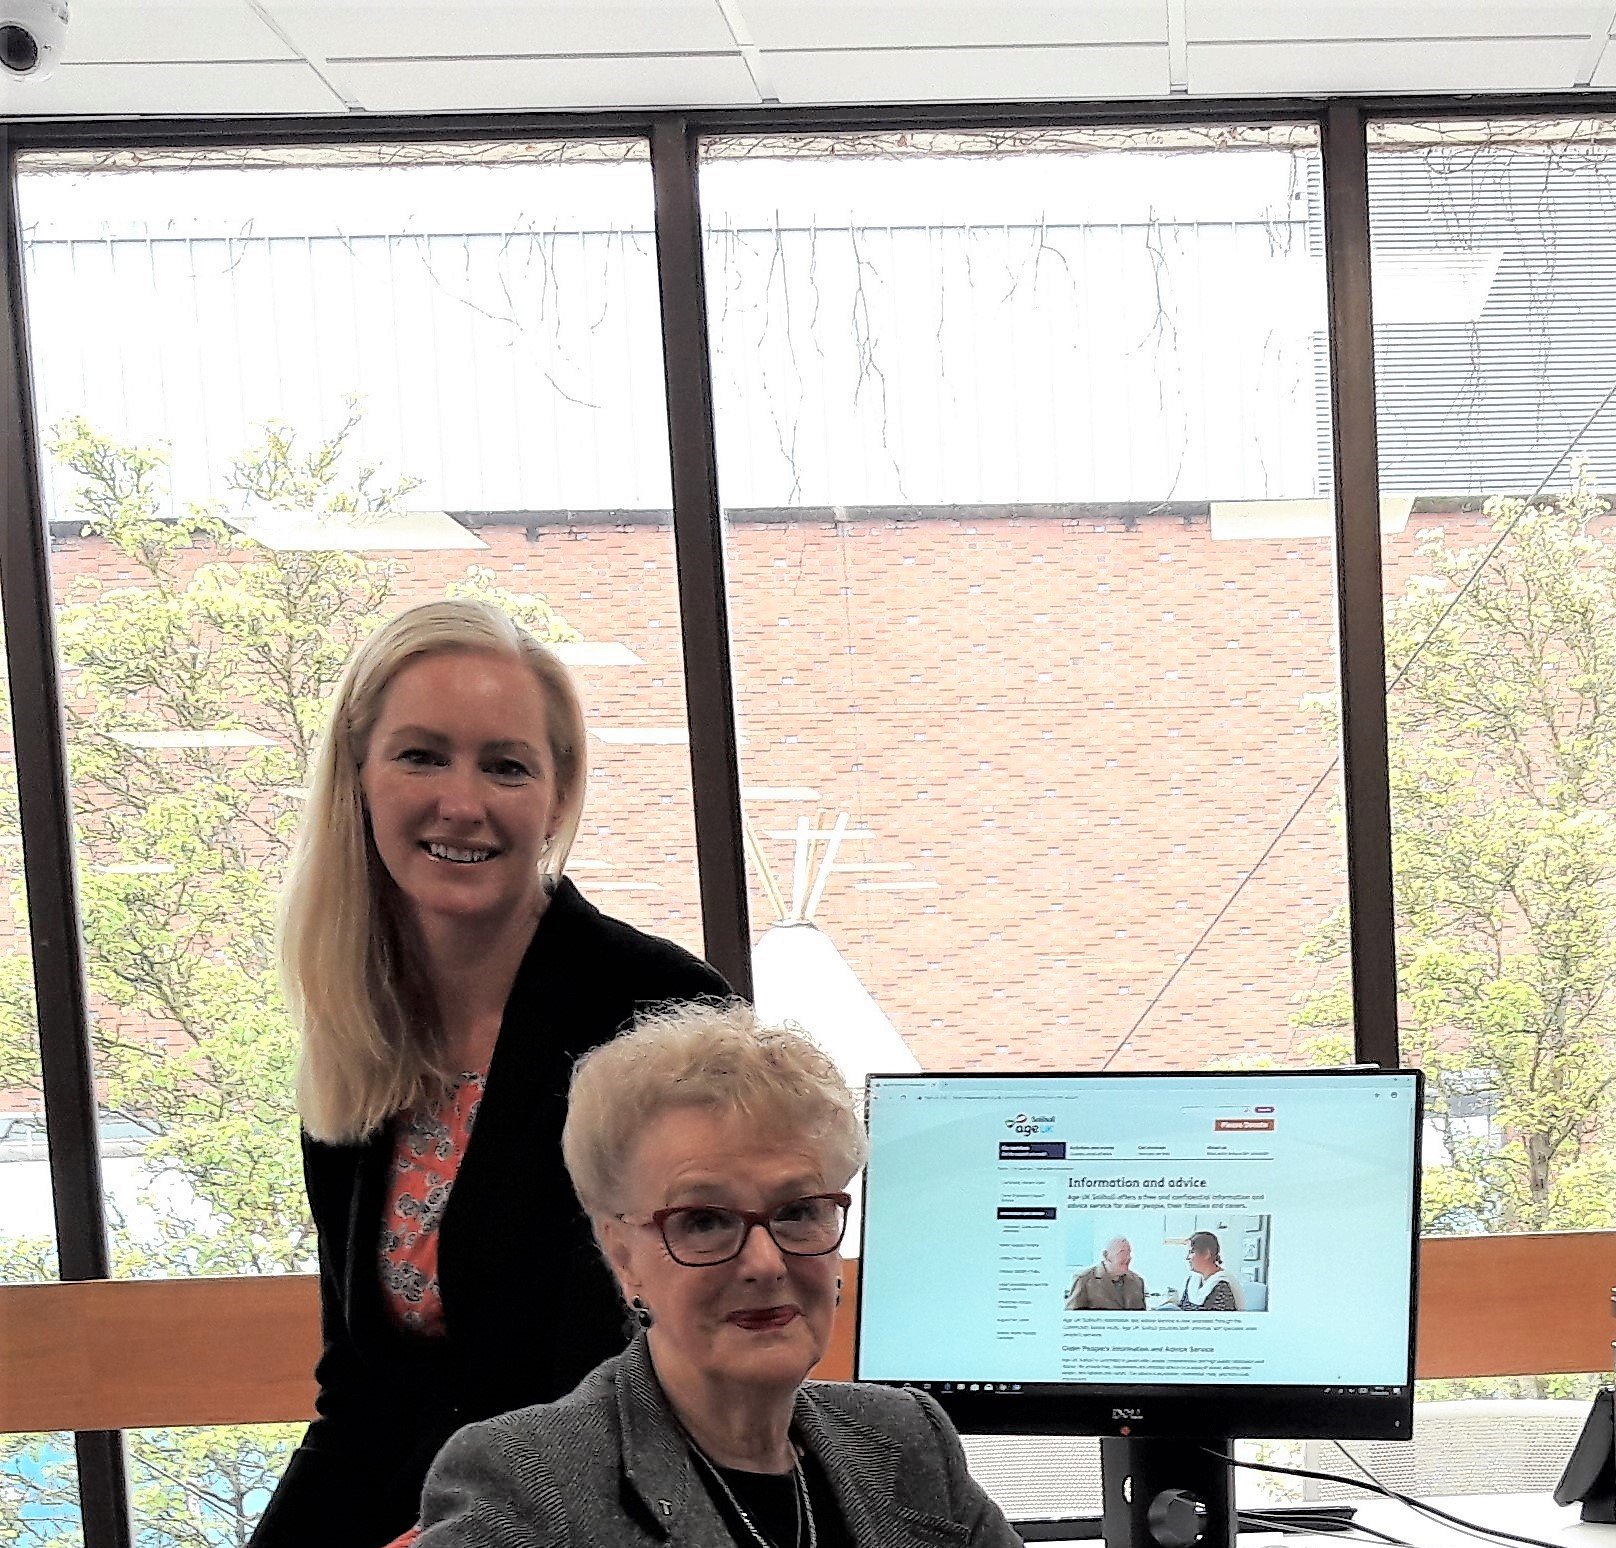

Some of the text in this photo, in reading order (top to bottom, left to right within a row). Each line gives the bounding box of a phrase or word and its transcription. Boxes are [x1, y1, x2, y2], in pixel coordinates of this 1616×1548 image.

[1015, 1124, 1040, 1136] age
[1068, 1176, 1207, 1188] Information and advice
